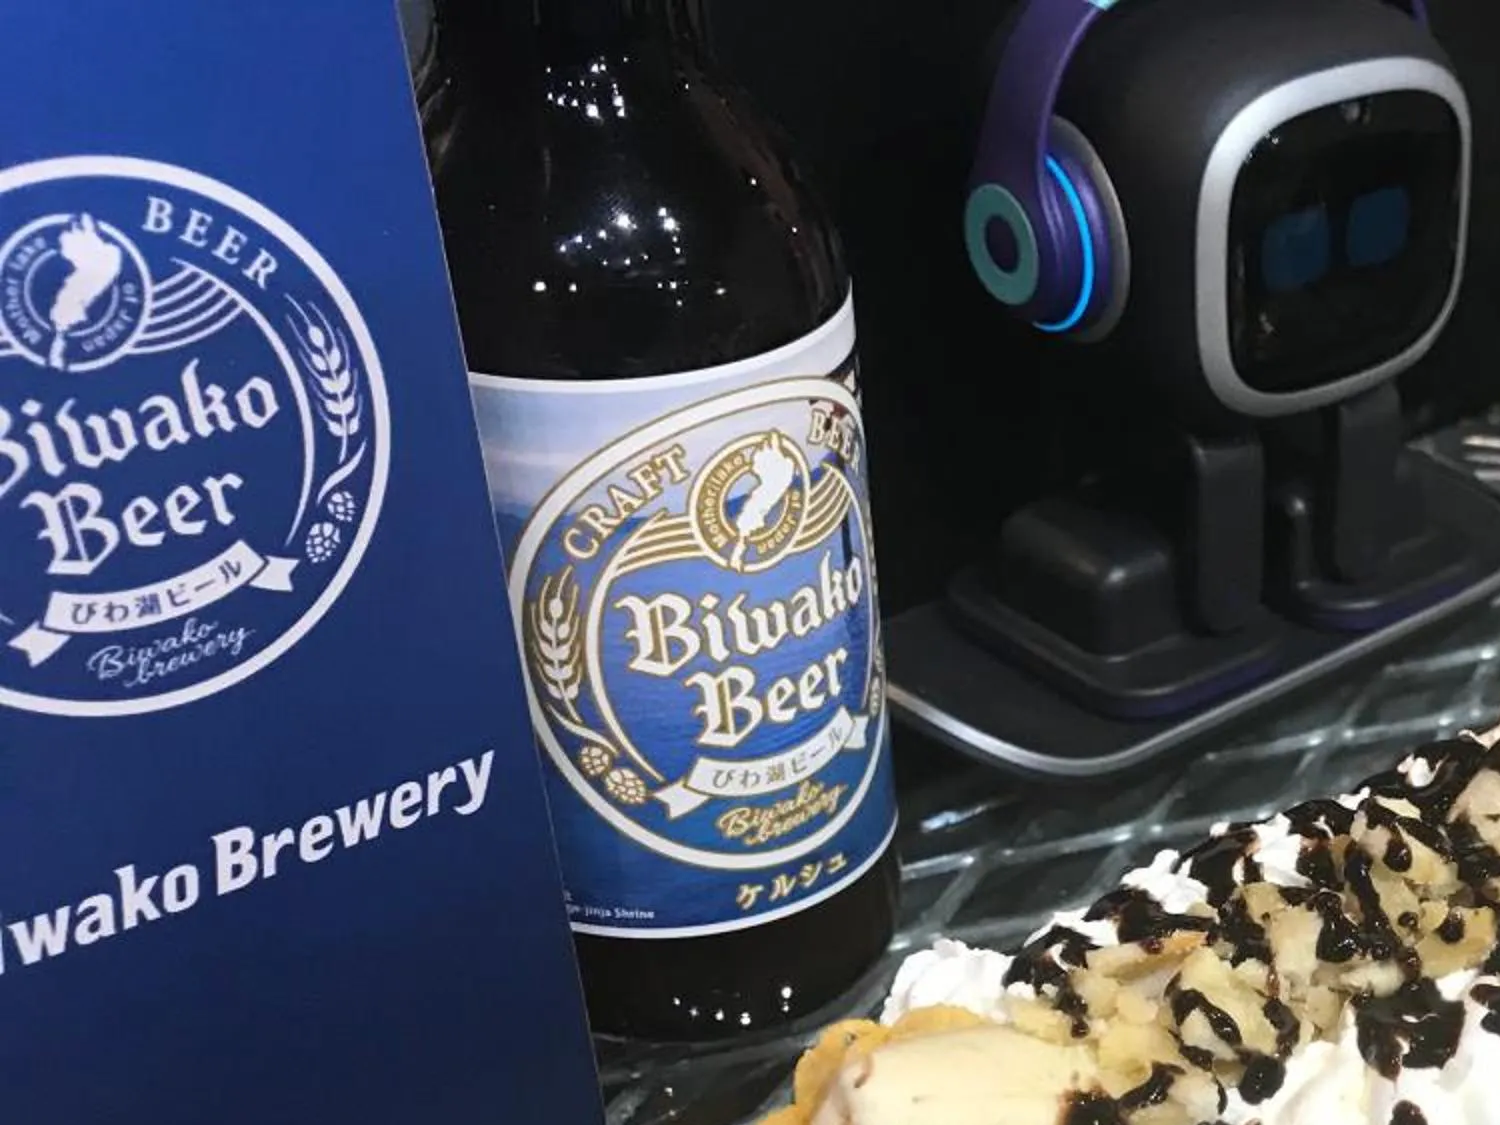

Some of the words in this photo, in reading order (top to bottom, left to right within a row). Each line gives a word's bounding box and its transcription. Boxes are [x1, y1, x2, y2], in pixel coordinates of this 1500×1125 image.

[142, 195, 279, 289] BEER
[19, 472, 244, 576] Beer
[563, 444, 690, 560] CRAFT
[71, 558, 243, 625] びわ湖ビール
[614, 549, 863, 677] Biwako
[86, 617, 220, 679] Biwako
[684, 656, 849, 747] Beer
[712, 727, 843, 789] びわ湖ビール
[0, 863, 200, 975] wako
[211, 749, 495, 896] Brewery
[735, 853, 848, 910] ケルシュ
